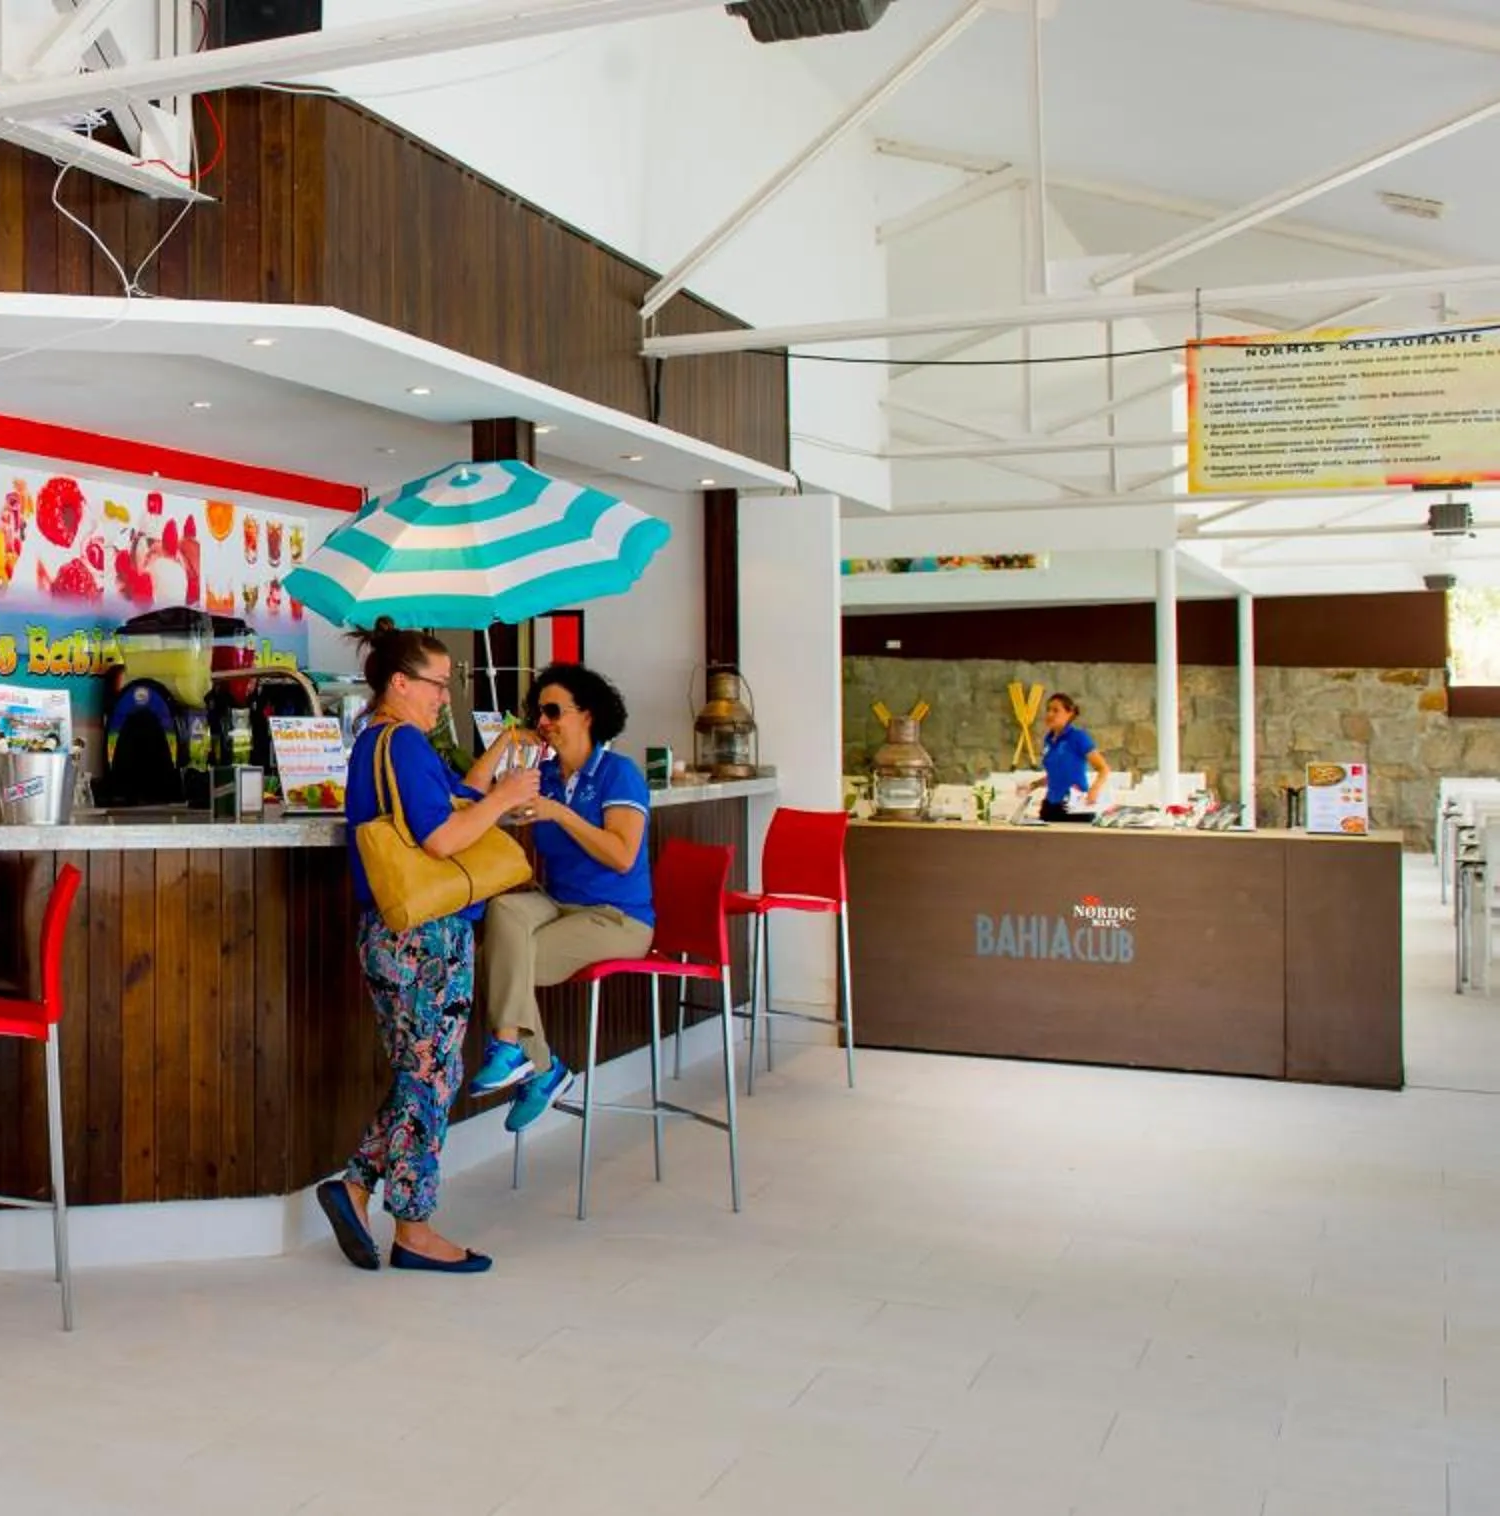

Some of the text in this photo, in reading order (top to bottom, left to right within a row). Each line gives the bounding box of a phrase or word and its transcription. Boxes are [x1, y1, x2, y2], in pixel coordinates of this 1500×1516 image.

[1245, 333, 1482, 357] NORMAS RESTAURANTE
[1071, 904, 1138, 921] NORDIC
